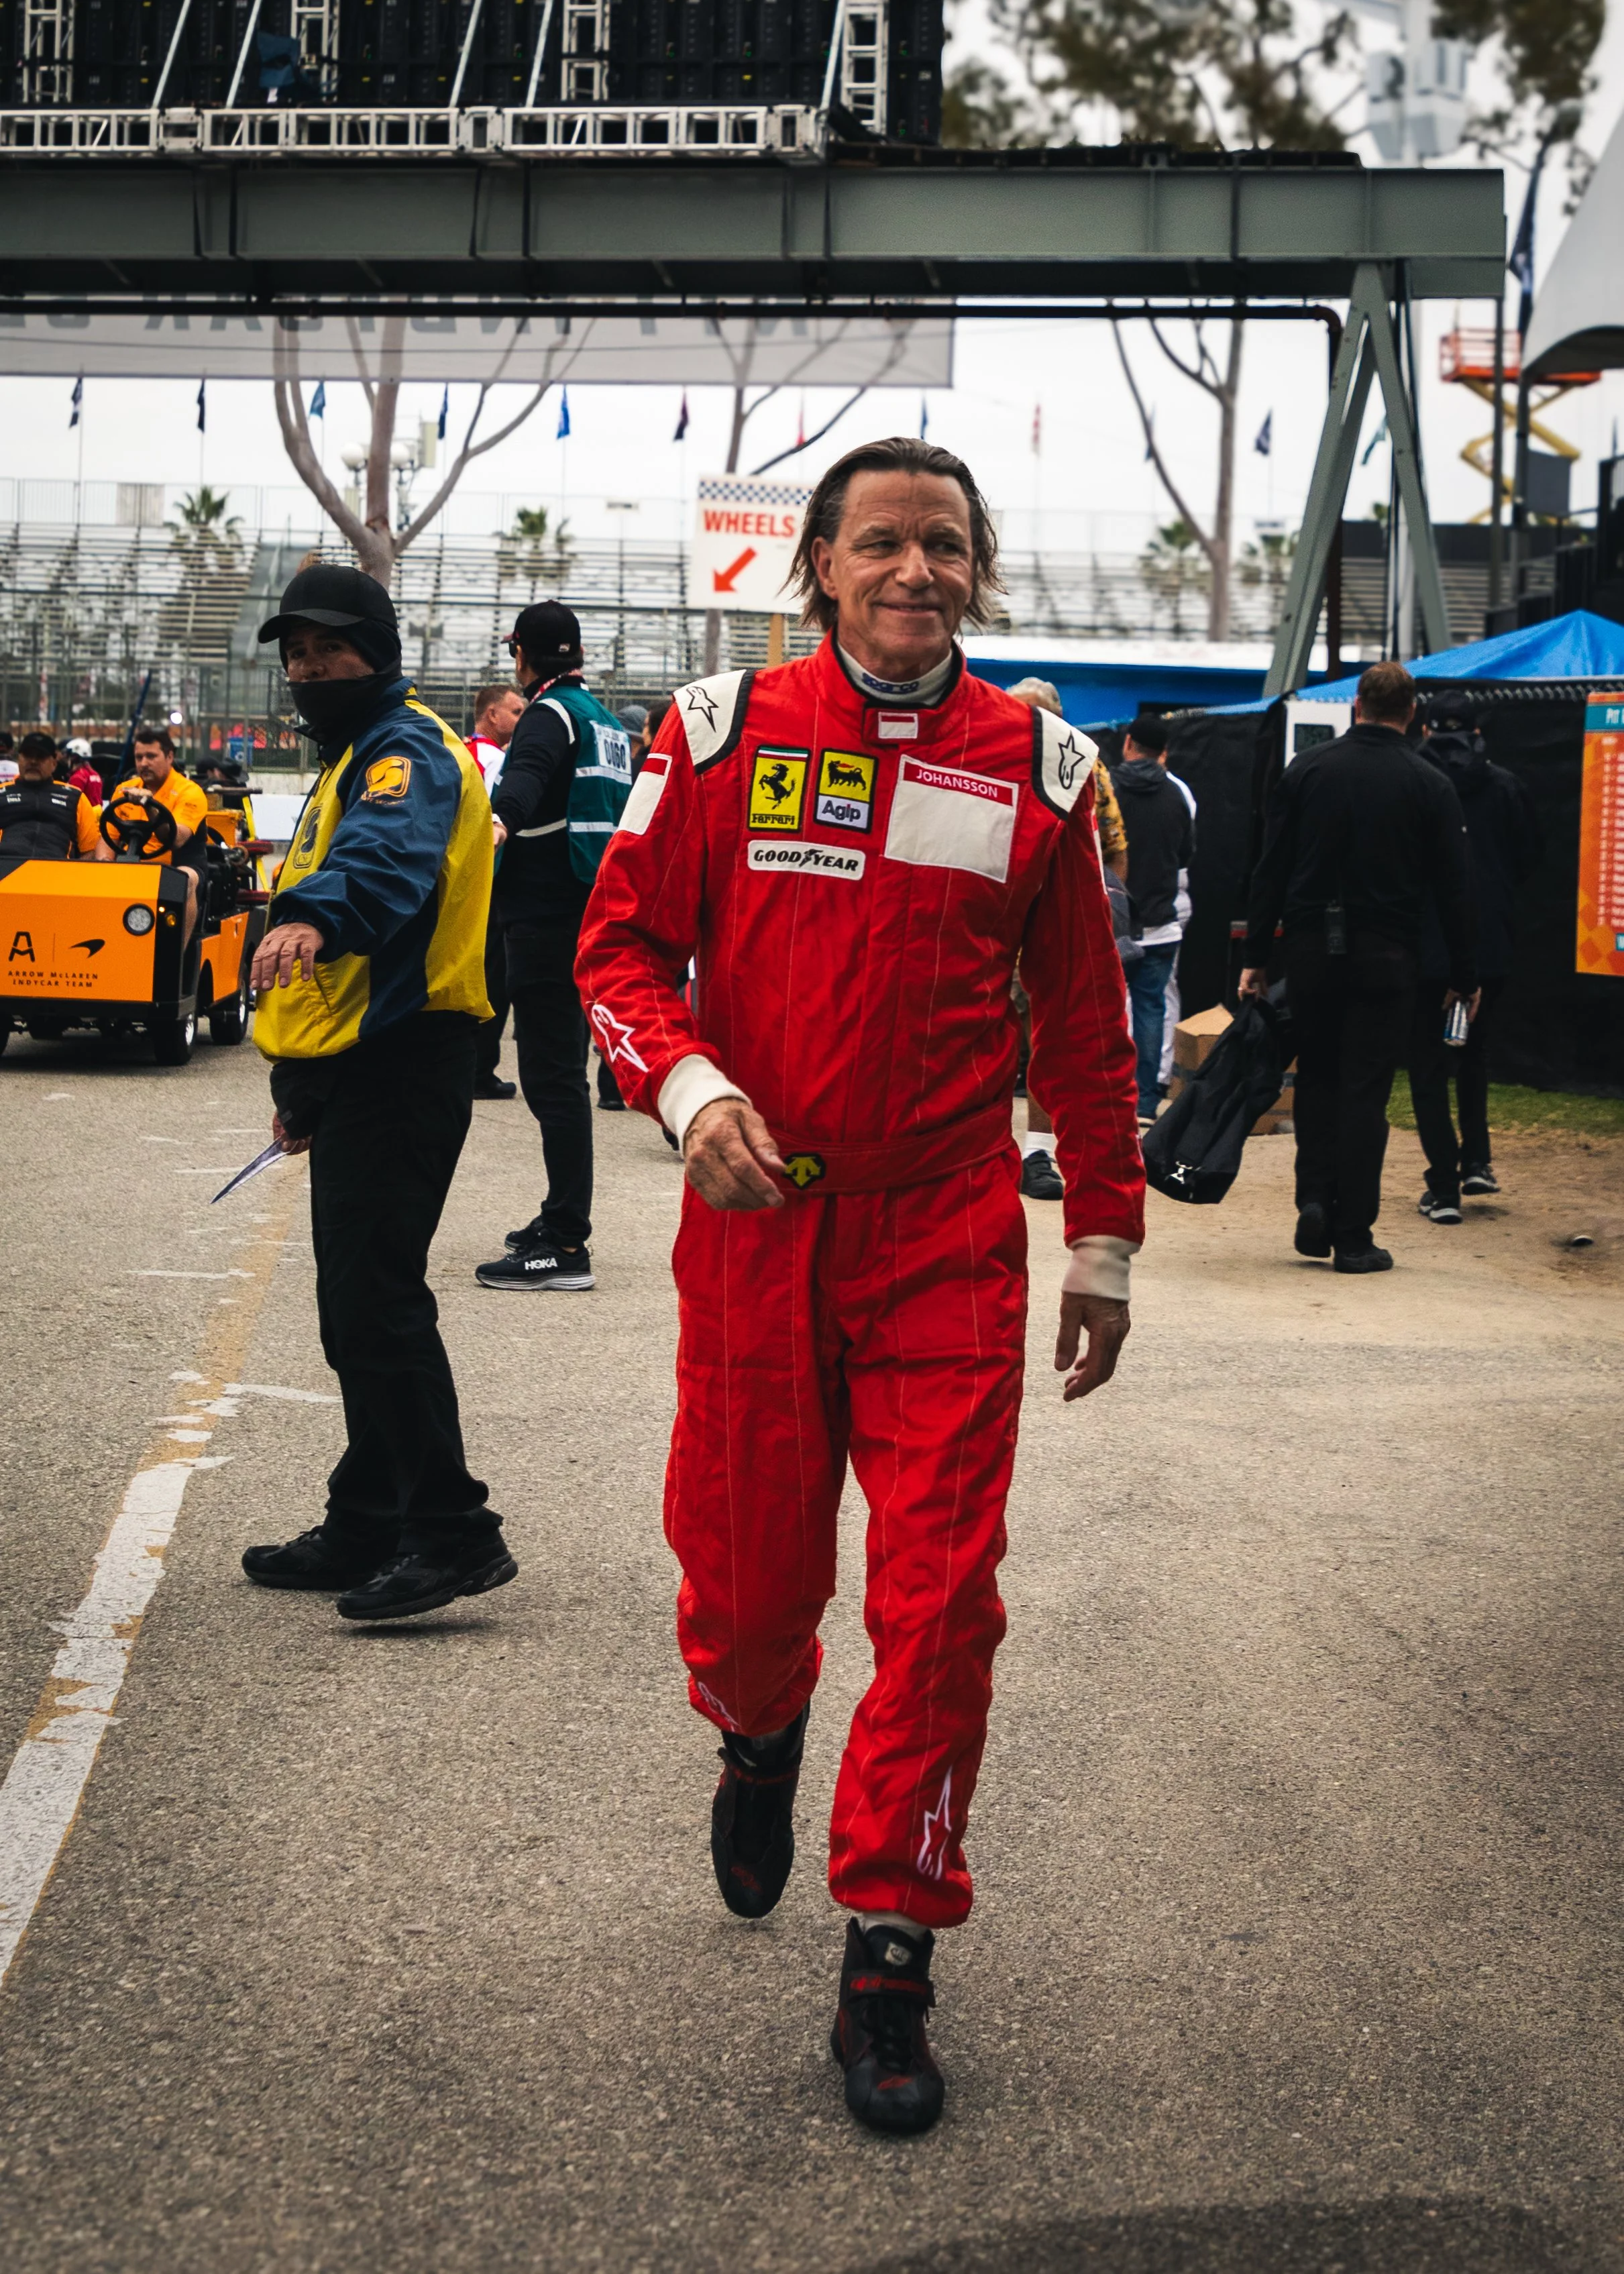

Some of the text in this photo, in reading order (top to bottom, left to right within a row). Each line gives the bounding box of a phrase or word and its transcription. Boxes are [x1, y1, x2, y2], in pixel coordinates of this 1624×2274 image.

[704, 510, 796, 539] WHEELS
[916, 769, 998, 798] JOHANSSON
[751, 814, 795, 825] Ferrari
[821, 800, 861, 822] Agip
[525, 1258, 558, 1270] HOKA
